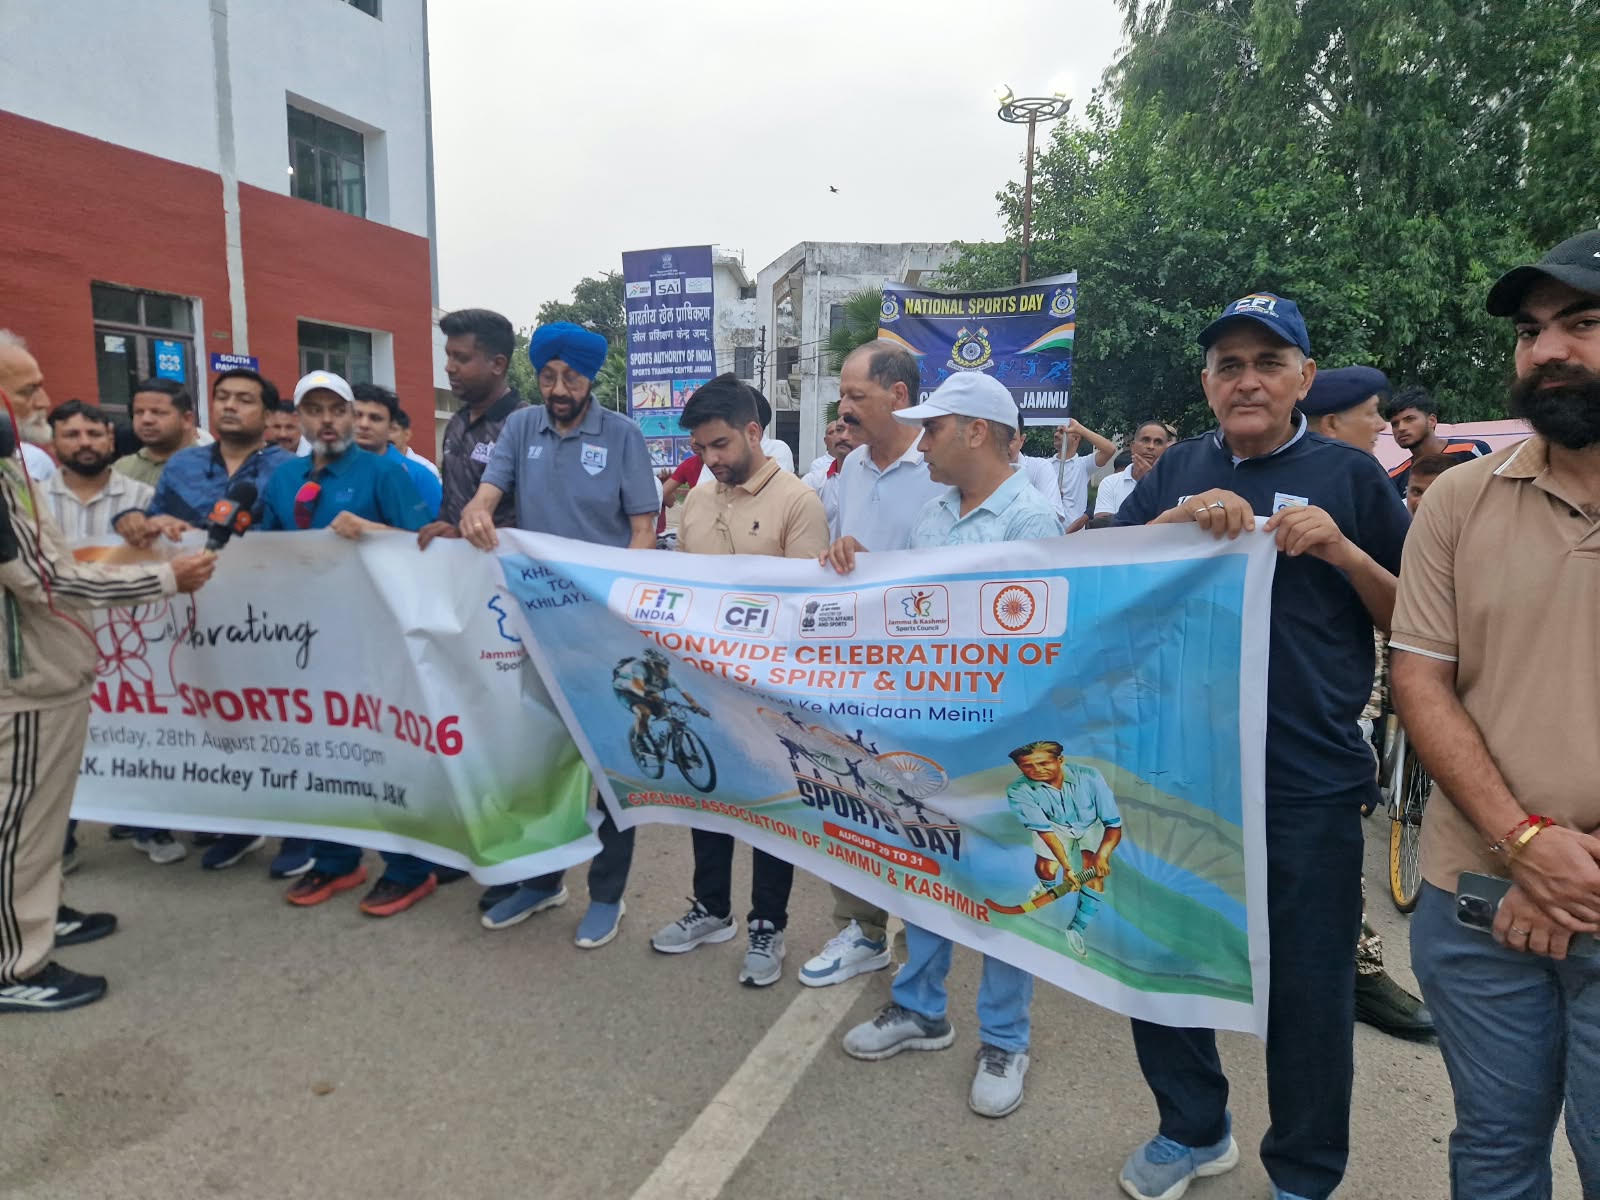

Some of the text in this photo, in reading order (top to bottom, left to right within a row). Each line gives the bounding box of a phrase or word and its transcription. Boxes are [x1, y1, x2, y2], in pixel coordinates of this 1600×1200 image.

[658, 283, 679, 294] SAI
[628, 301, 711, 326] भारतीय खेल प्राधिकरण
[905, 293, 1045, 315] NATIONAL SPORTS DAY
[220, 354, 250, 364] SOUTH
[630, 349, 713, 366] SPORTS AUTHORITY OF INDIA
[632, 367, 651, 377] SPORTS
[651, 366, 674, 375] TRAINING
[674, 366, 693, 374] CENTRE
[1020, 391, 1069, 409] JAMMU
[585, 450, 604, 460] CFI
[635, 608, 675, 622] INDIA
[725, 607, 769, 628] CFI
[795, 643, 1009, 666] CELEBRATION
[1017, 642, 1063, 666] OF
[768, 667, 866, 689] SPIRIT
[873, 671, 896, 691] &
[905, 671, 1005, 693] UNITY
[177, 682, 313, 724] SPORTS
[323, 690, 383, 733] DAY
[387, 705, 463, 756] 2026
[800, 700, 994, 723] Ke Maidaan Mein!!
[156, 728, 195, 747] 28th
[202, 730, 255, 755] August
[260, 734, 300, 756] 2026
[305, 741, 321, 758] at
[325, 740, 387, 766] 5:00pm
[111, 757, 175, 780] Hakhu
[182, 759, 252, 791] Hockey
[259, 767, 298, 790] Turf
[305, 772, 378, 799] Jammu,
[383, 781, 408, 808] J&K
[797, 780, 961, 862] SPORTS DAY
[628, 792, 990, 922] CYCLING ASSOCIATION OF JAMMU & KASHMIR
[838, 830, 876, 849] AUGUST
[893, 850, 908, 862] TO
[910, 854, 923, 866] 31
